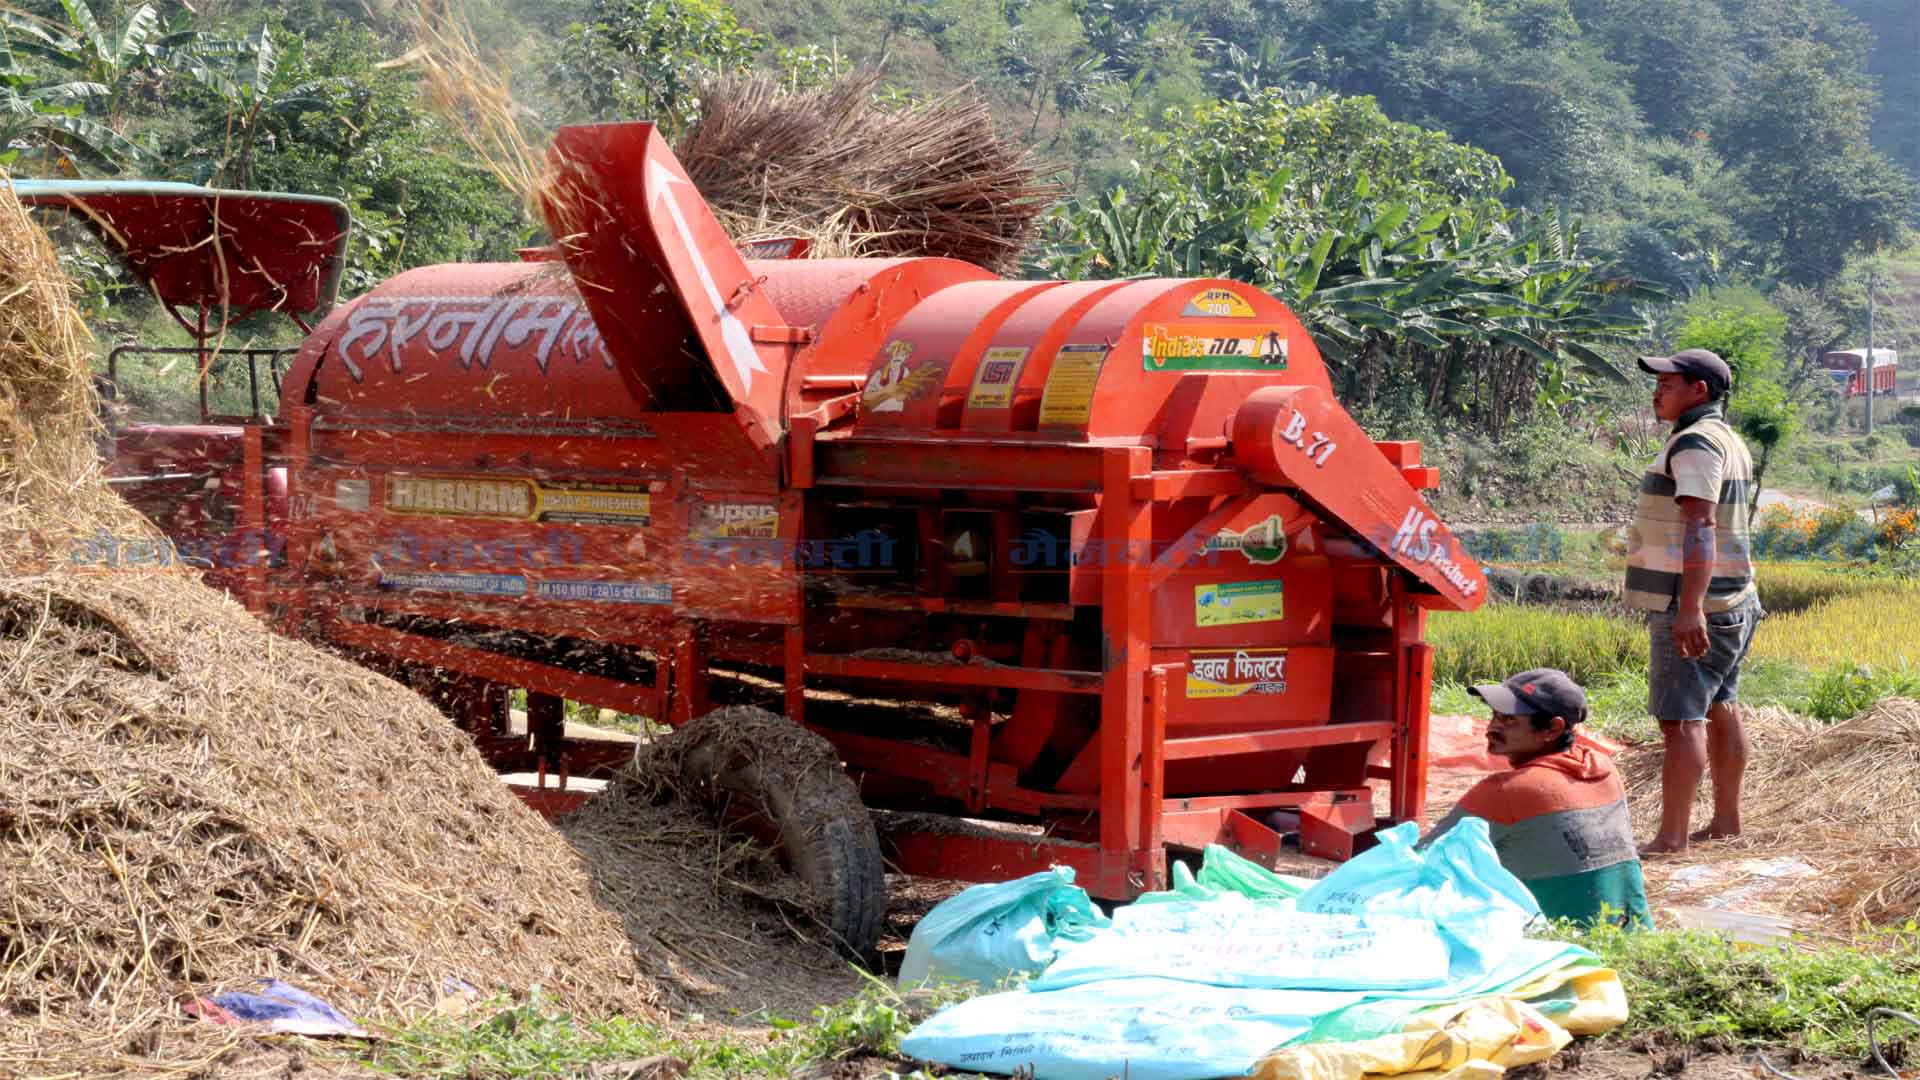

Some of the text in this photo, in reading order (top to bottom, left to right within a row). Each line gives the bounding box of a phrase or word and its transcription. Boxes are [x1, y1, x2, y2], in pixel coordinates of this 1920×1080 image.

[1207, 292, 1232, 300] RPM
[1208, 303, 1231, 315] 700
[1249, 335, 1264, 358] 1
[391, 479, 530, 516] HARNAM
[1192, 658, 1230, 681] डबल
